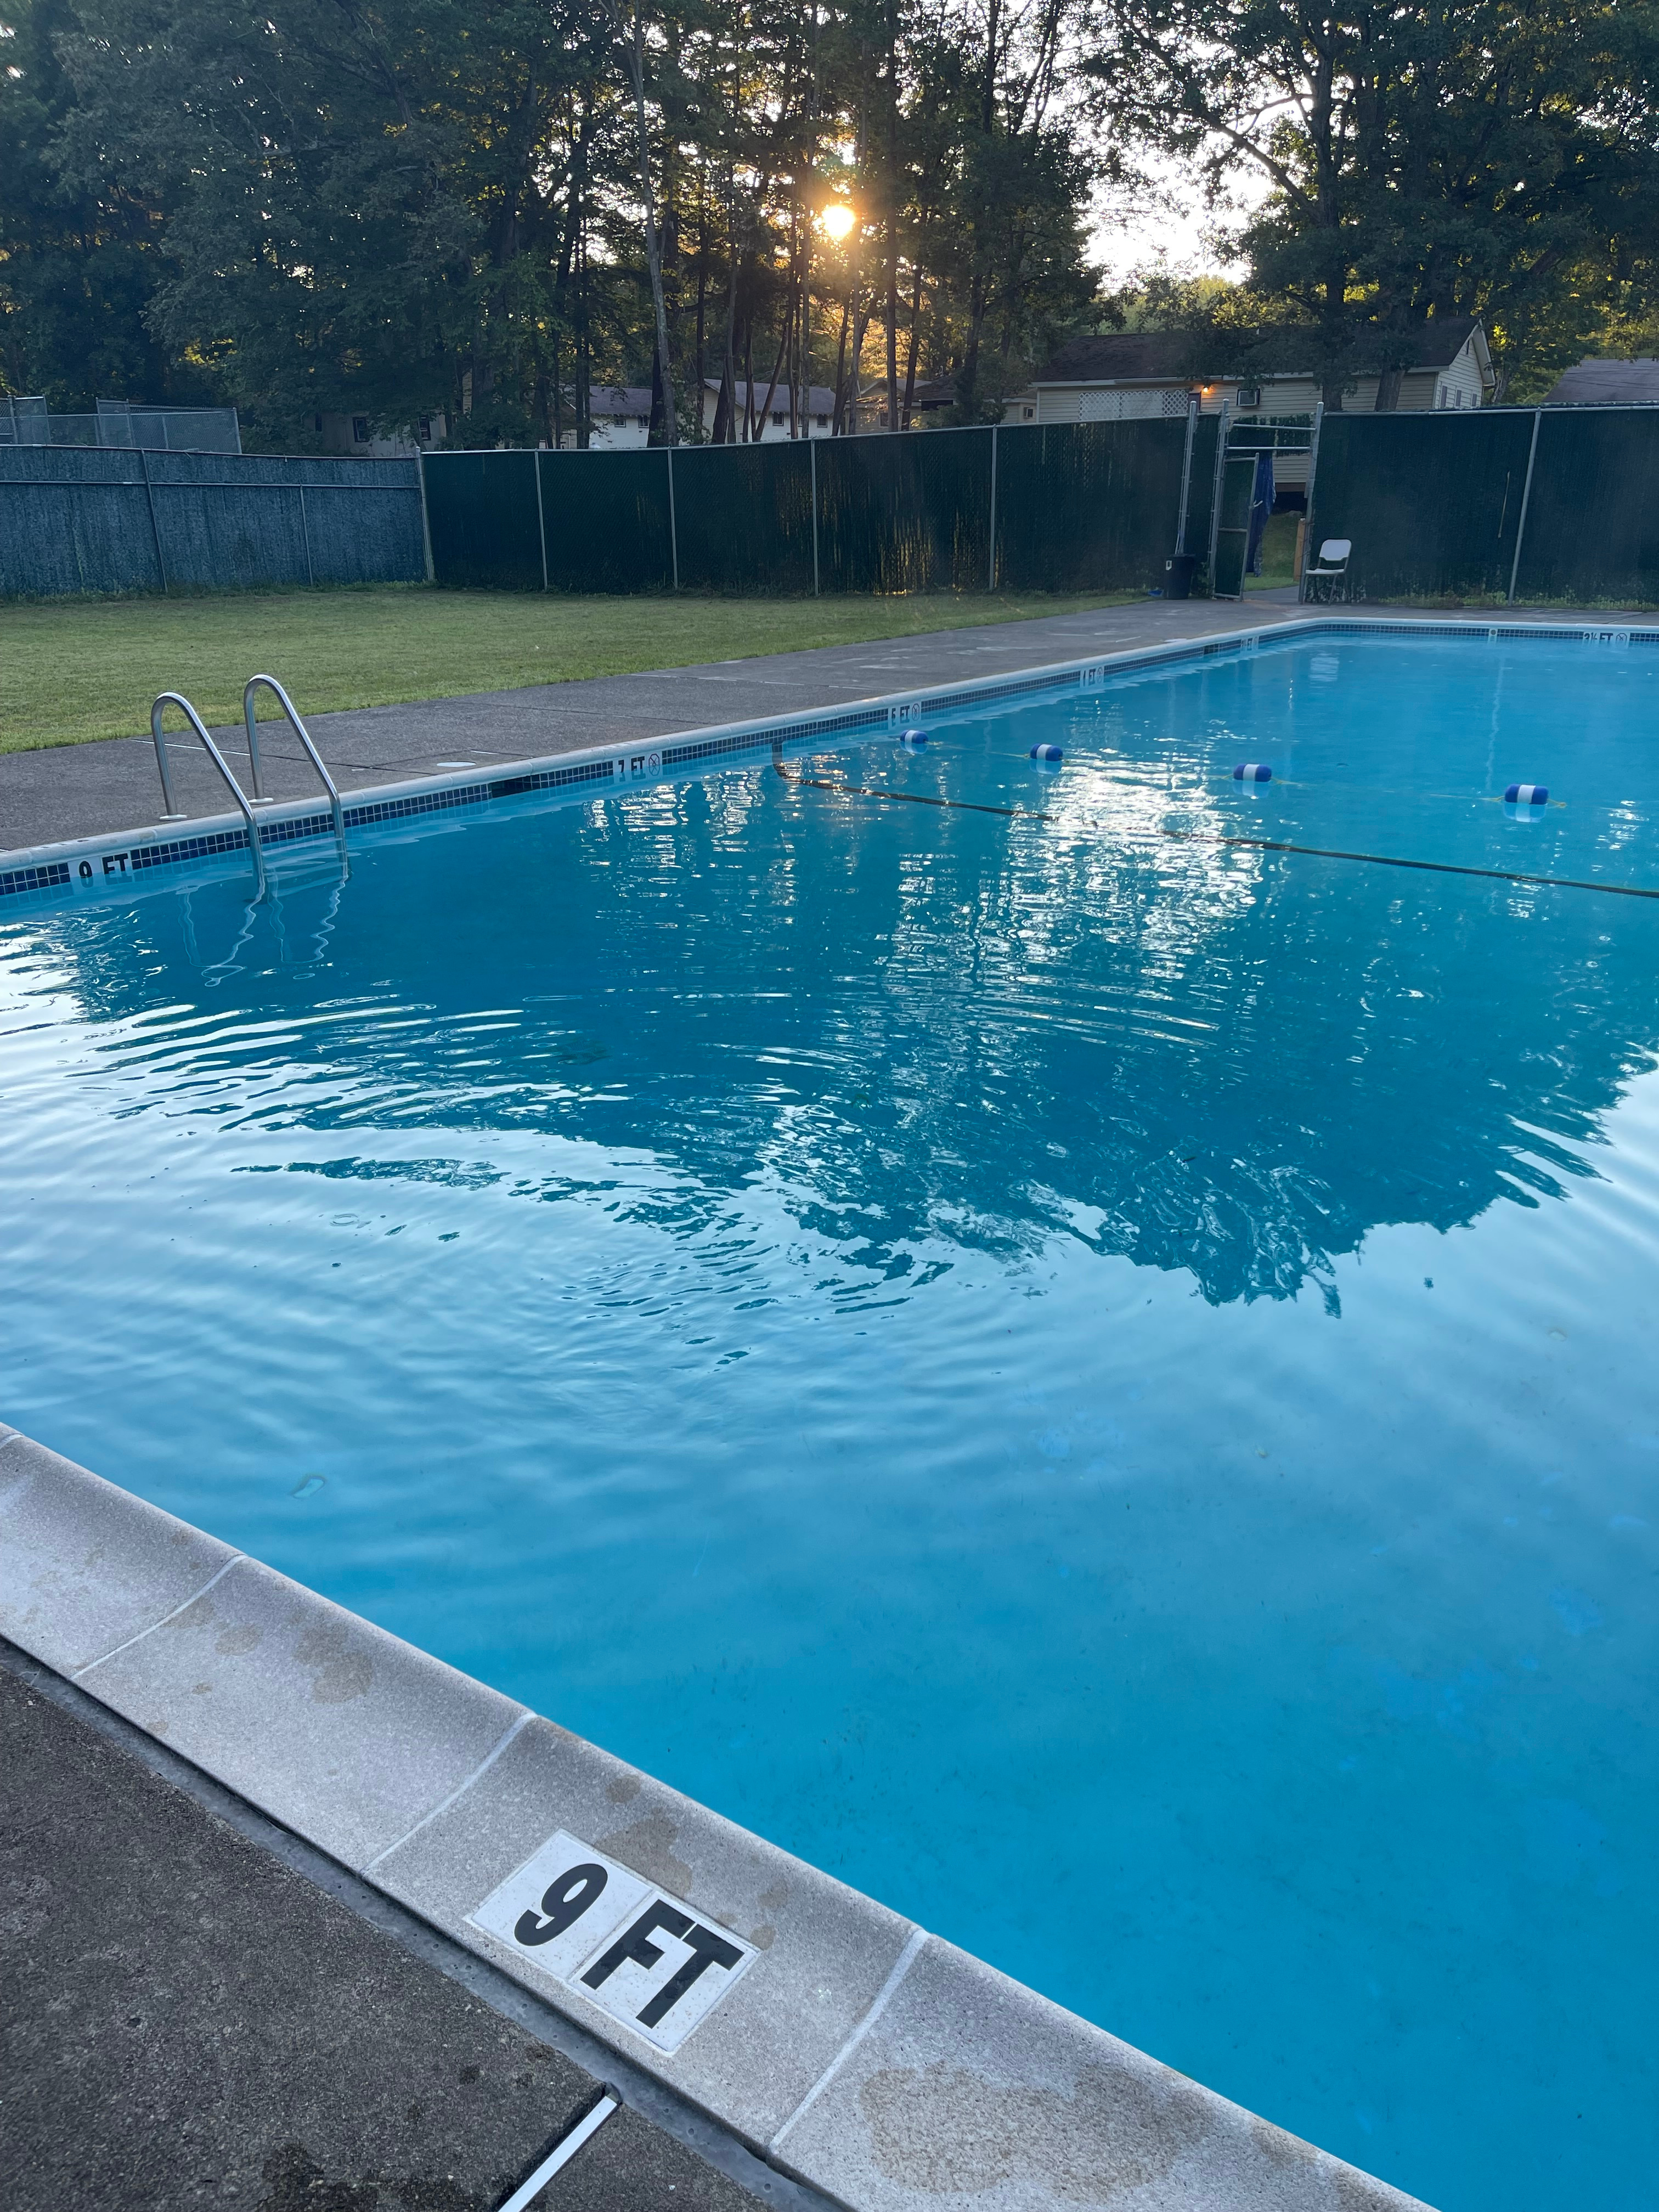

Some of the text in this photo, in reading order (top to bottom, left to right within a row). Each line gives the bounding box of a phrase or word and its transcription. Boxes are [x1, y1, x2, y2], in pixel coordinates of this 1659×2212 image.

[1599, 633, 1613, 641] FT
[900, 705, 910, 717] FT
[631, 756, 645, 771] FT
[102, 853, 128, 874] FT
[514, 1863, 745, 2029] 9 FT
